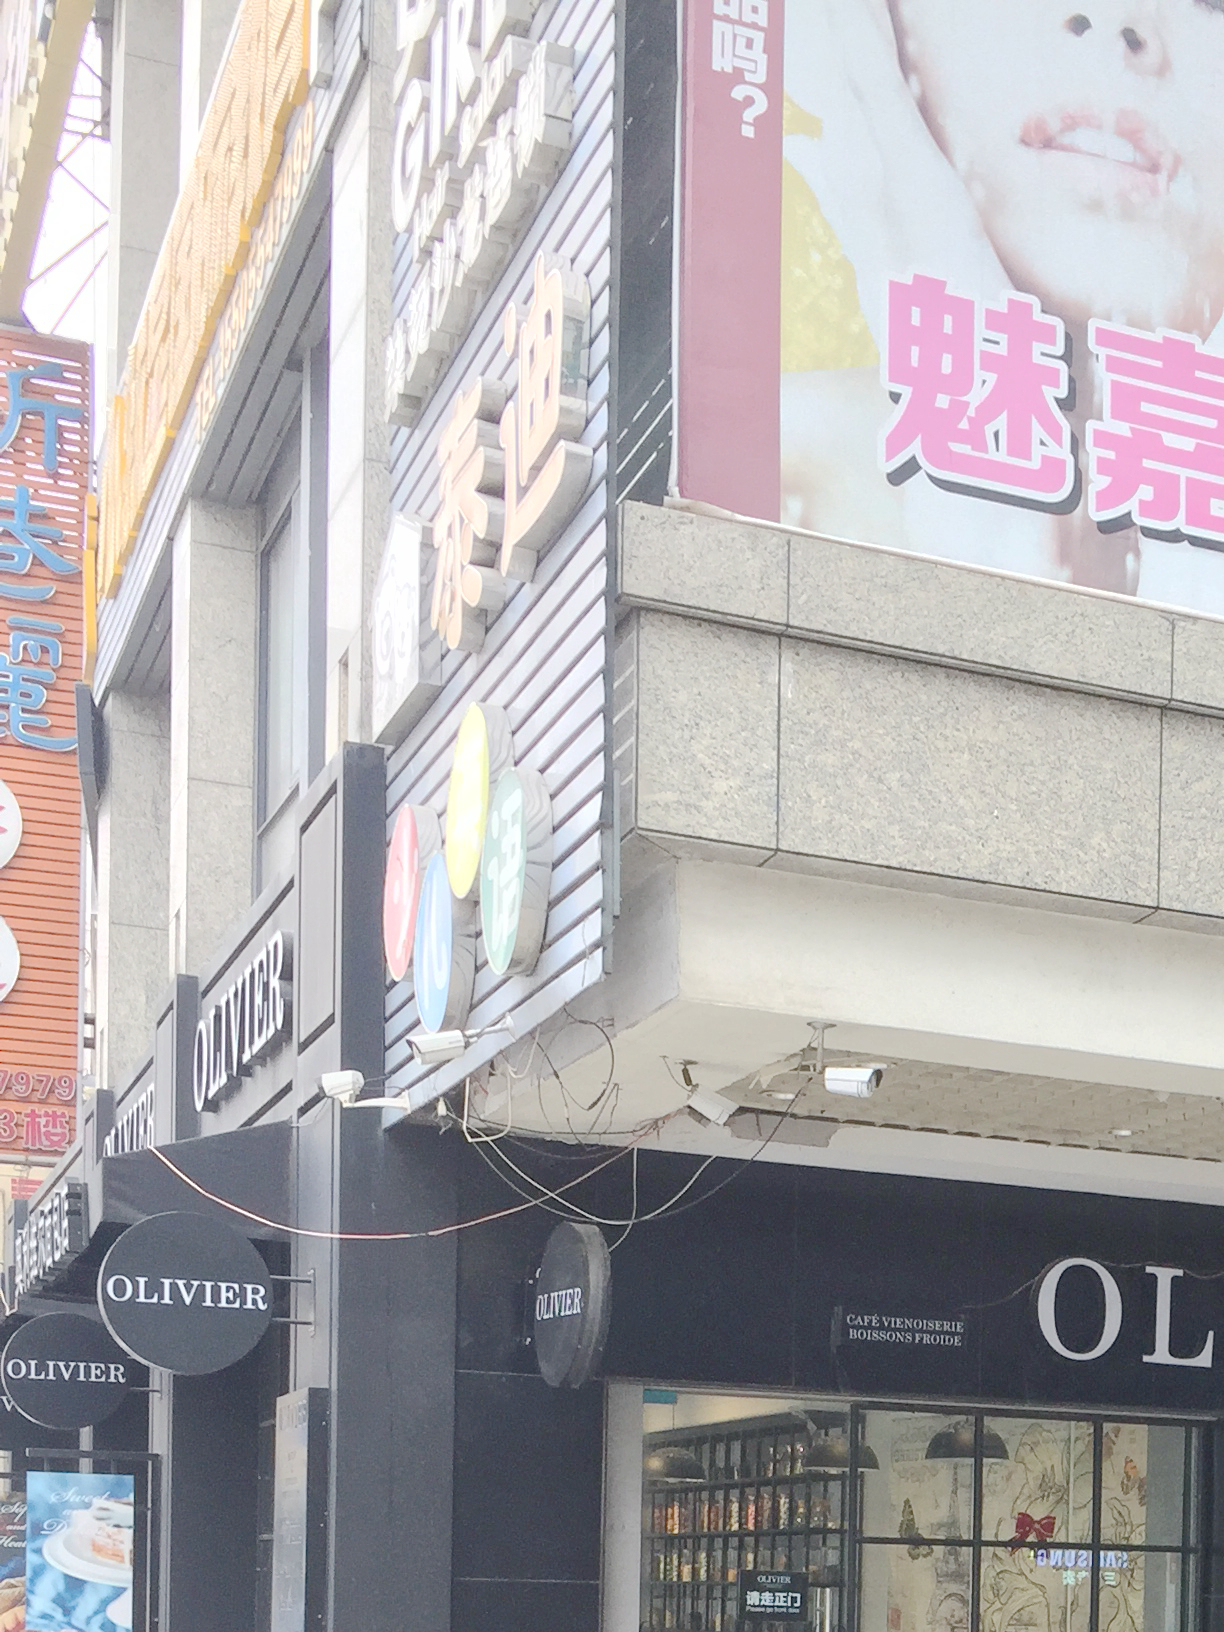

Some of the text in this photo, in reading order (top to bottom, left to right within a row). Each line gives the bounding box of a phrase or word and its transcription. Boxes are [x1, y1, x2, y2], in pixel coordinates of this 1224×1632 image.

[193, 930, 286, 1113] OLIVIER
[106, 1275, 268, 1310] OLIVIER
[535, 1287, 582, 1320] OLIVIER
[846, 1313, 964, 1333] CAFÉ VIENOISERIE
[849, 1328, 962, 1346] BOISSONS FROIDE
[7, 1358, 126, 1384] OLIVIER
[757, 1575, 791, 1584] OLIVIER
[746, 1590, 801, 1607] 请走正门
